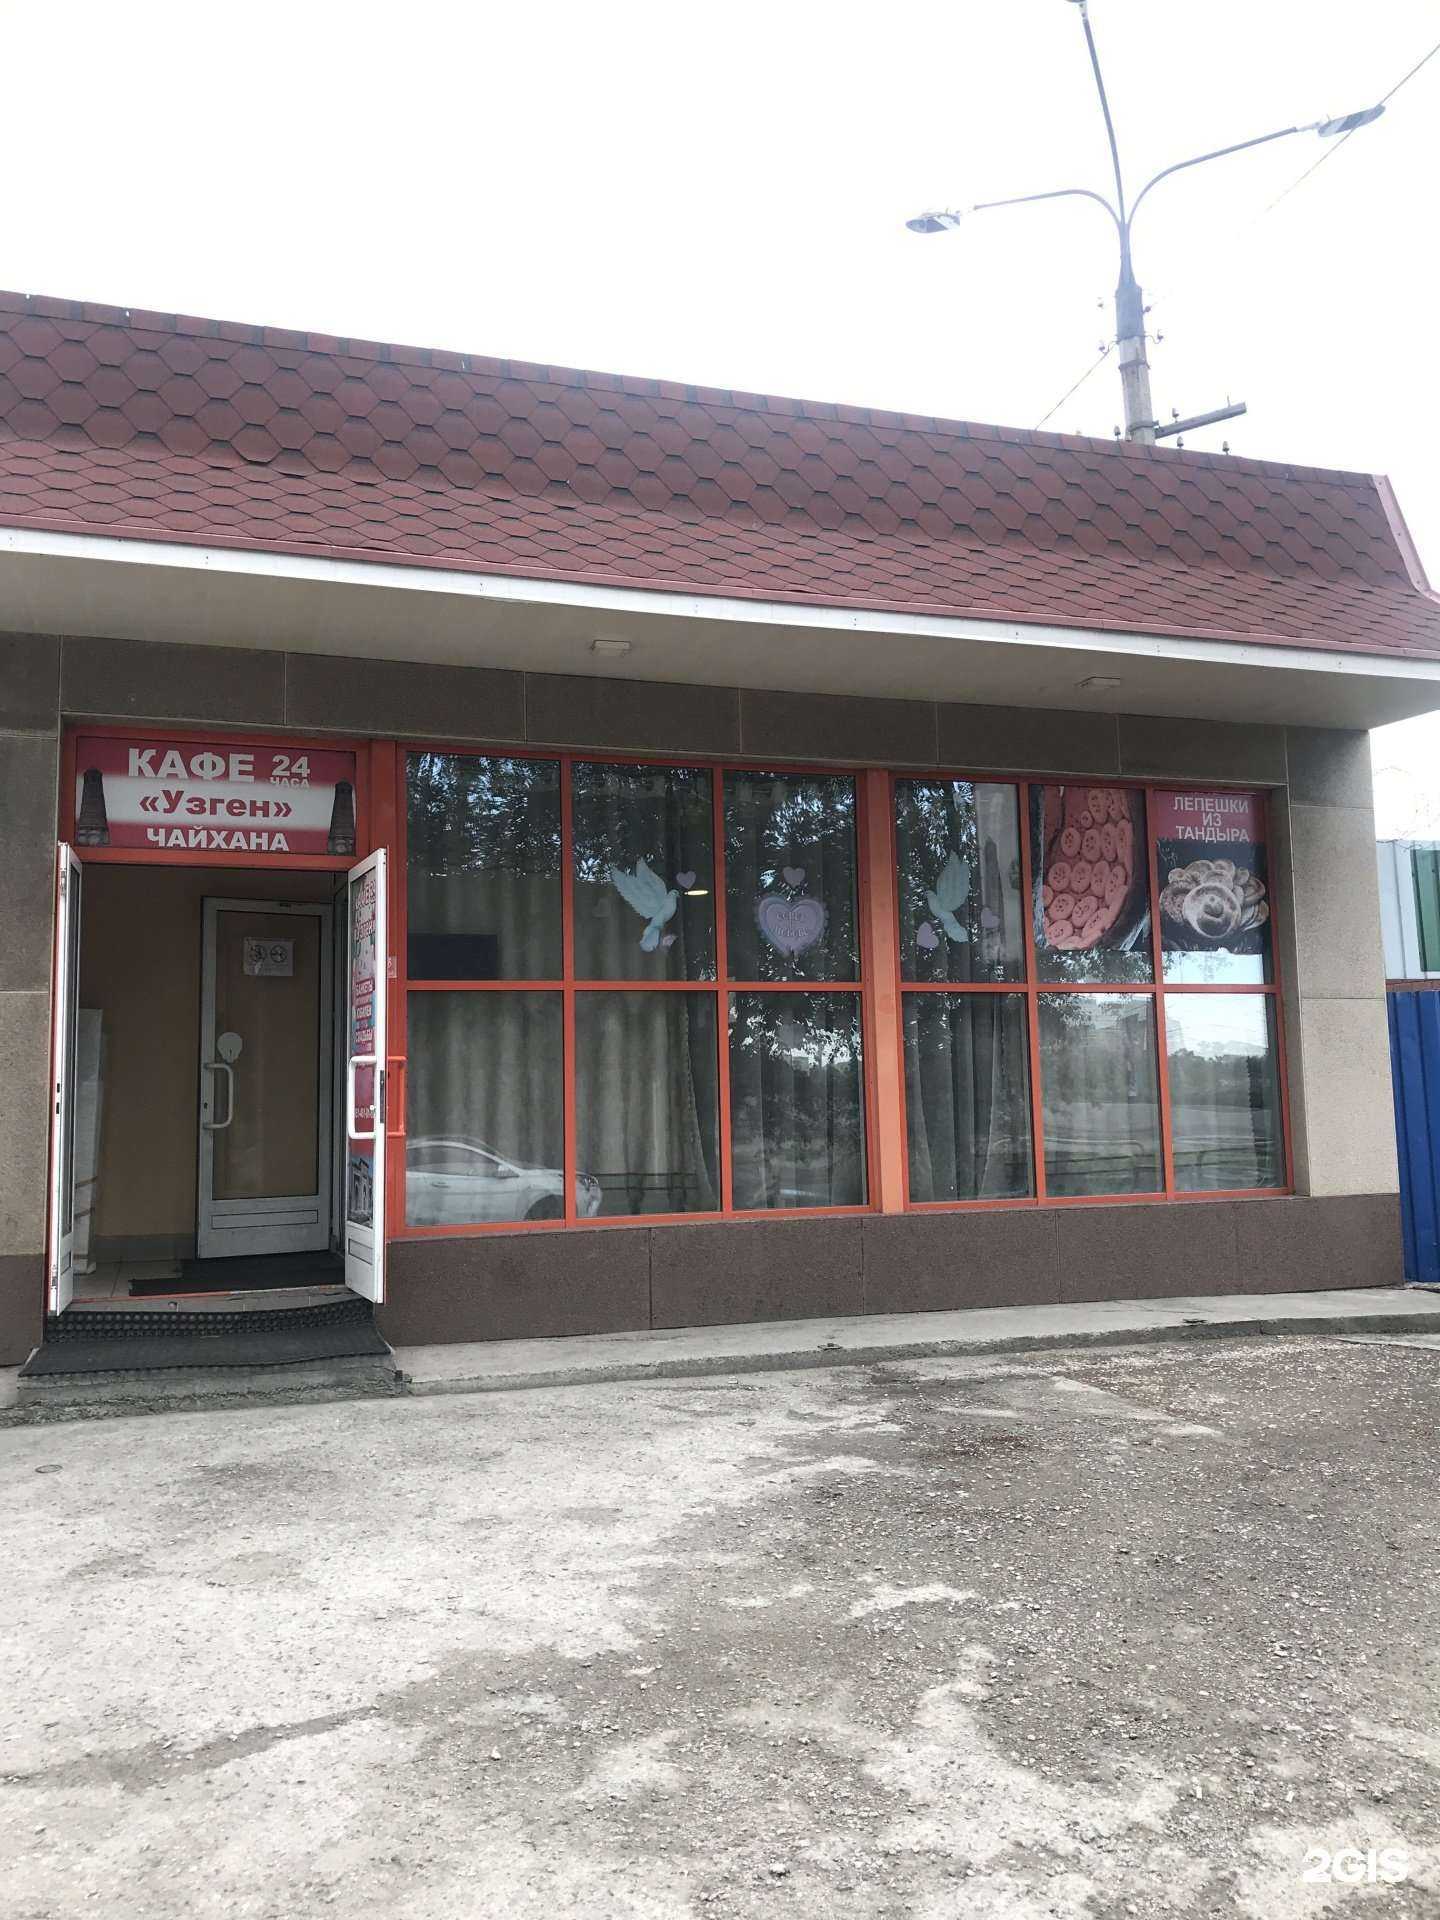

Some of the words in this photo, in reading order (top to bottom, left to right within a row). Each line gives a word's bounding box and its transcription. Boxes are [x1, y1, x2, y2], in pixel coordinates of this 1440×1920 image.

[128, 748, 255, 783] КАФЕ
[271, 755, 311, 778] 24
[270, 776, 310, 789] ЧАСА
[139, 789, 293, 818] «Узген»
[1173, 796, 1249, 814] ЛЕПЕШКИ
[1202, 813, 1222, 827] ИЗ
[147, 826, 289, 851] ЧАЙХАНА
[1176, 826, 1250, 843] ТАНДЫРА
